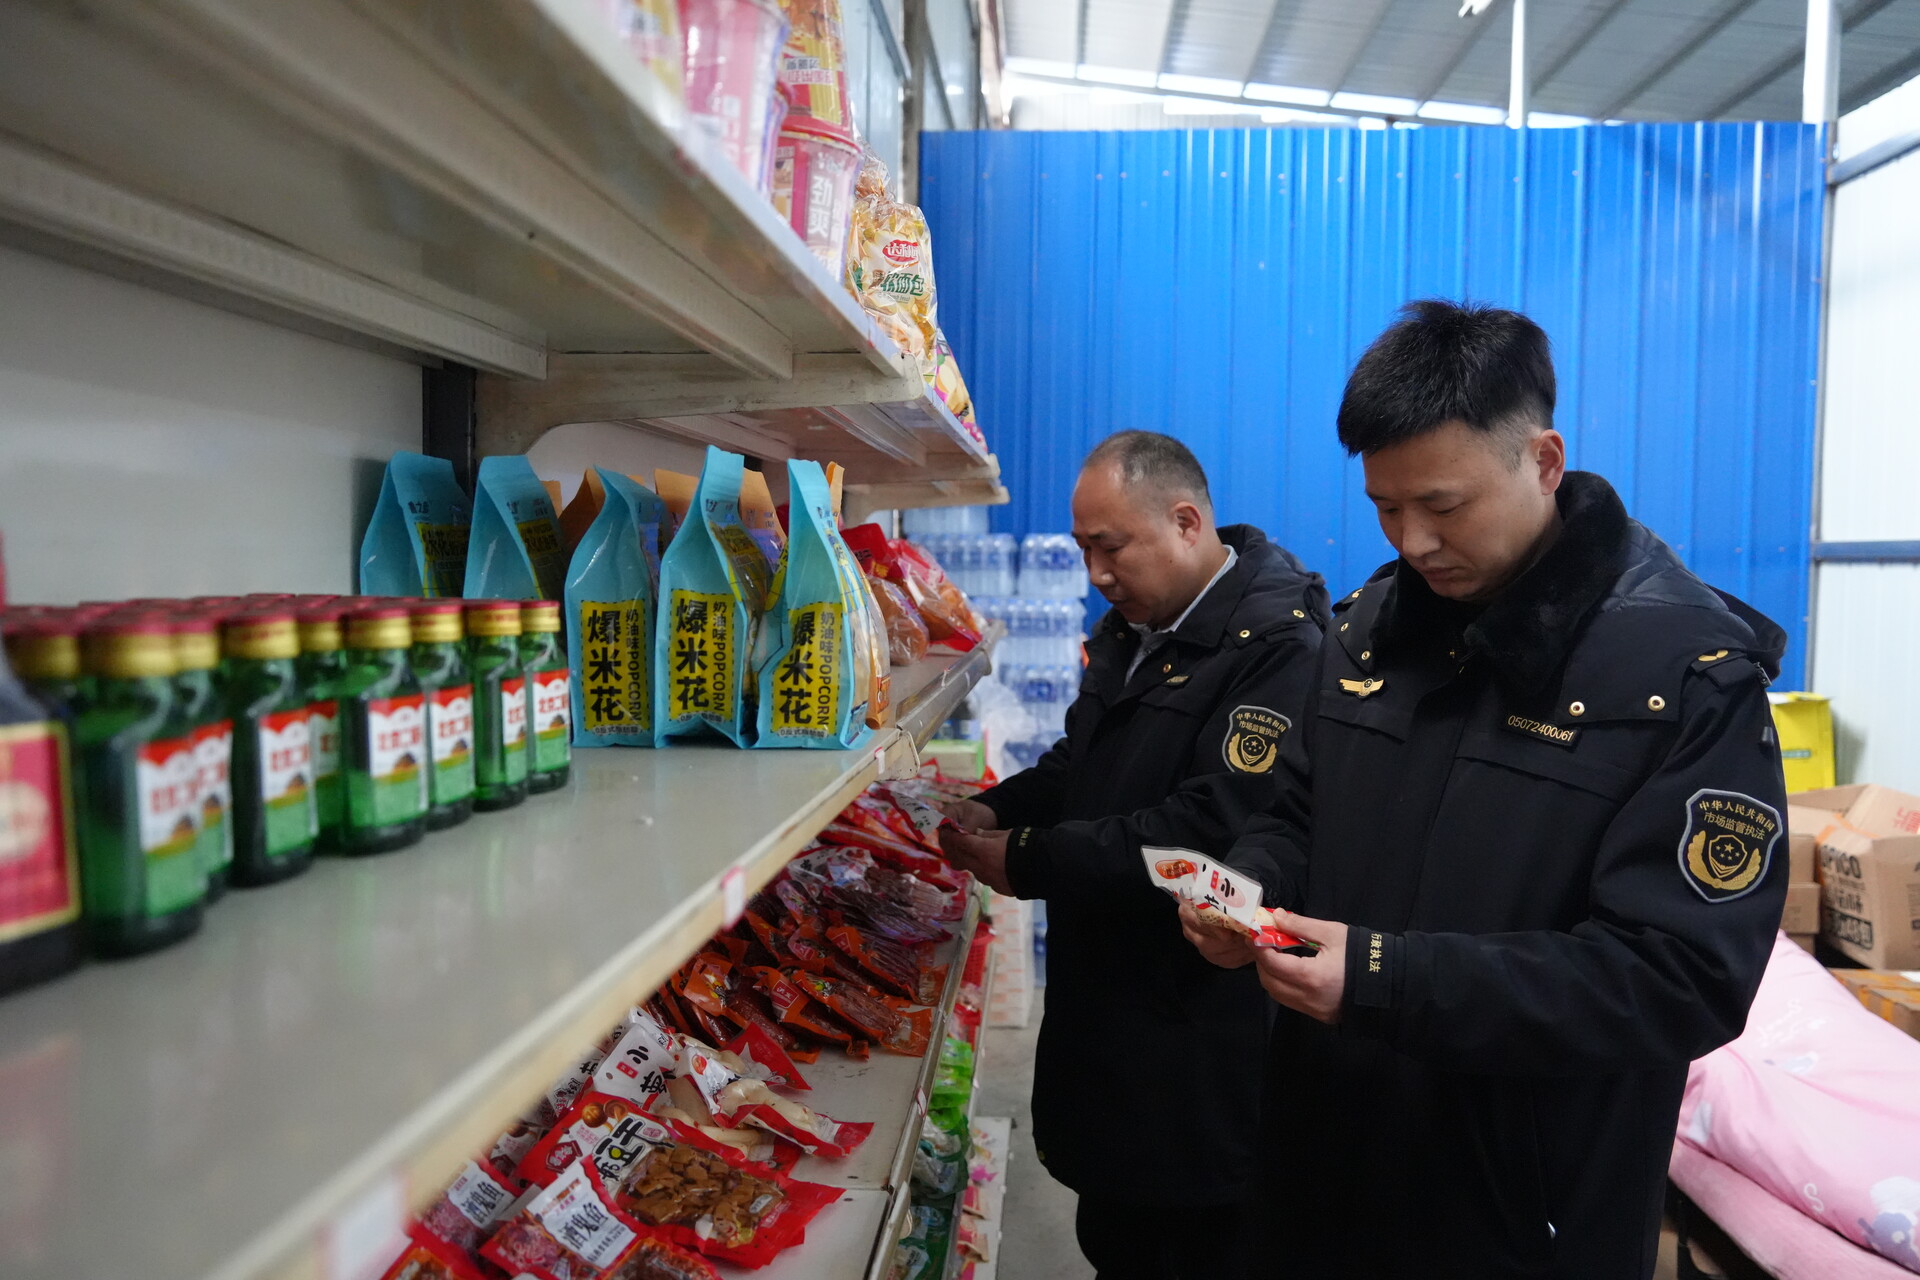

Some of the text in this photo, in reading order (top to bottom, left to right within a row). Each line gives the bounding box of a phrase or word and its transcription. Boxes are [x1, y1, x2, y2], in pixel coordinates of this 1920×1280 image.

[587, 609, 625, 723] 爆米花
[675, 598, 710, 711] 爆米花
[1236, 711, 1288, 734] 中华人民共和国
[1507, 715, 1575, 742] 05072400061
[1699, 799, 1776, 833] 中华人民共和国
[1703, 811, 1767, 841] 市场监管执法
[460, 1181, 505, 1225] 酒鬼鱼
[557, 1201, 609, 1251] 酒鬼鱼
